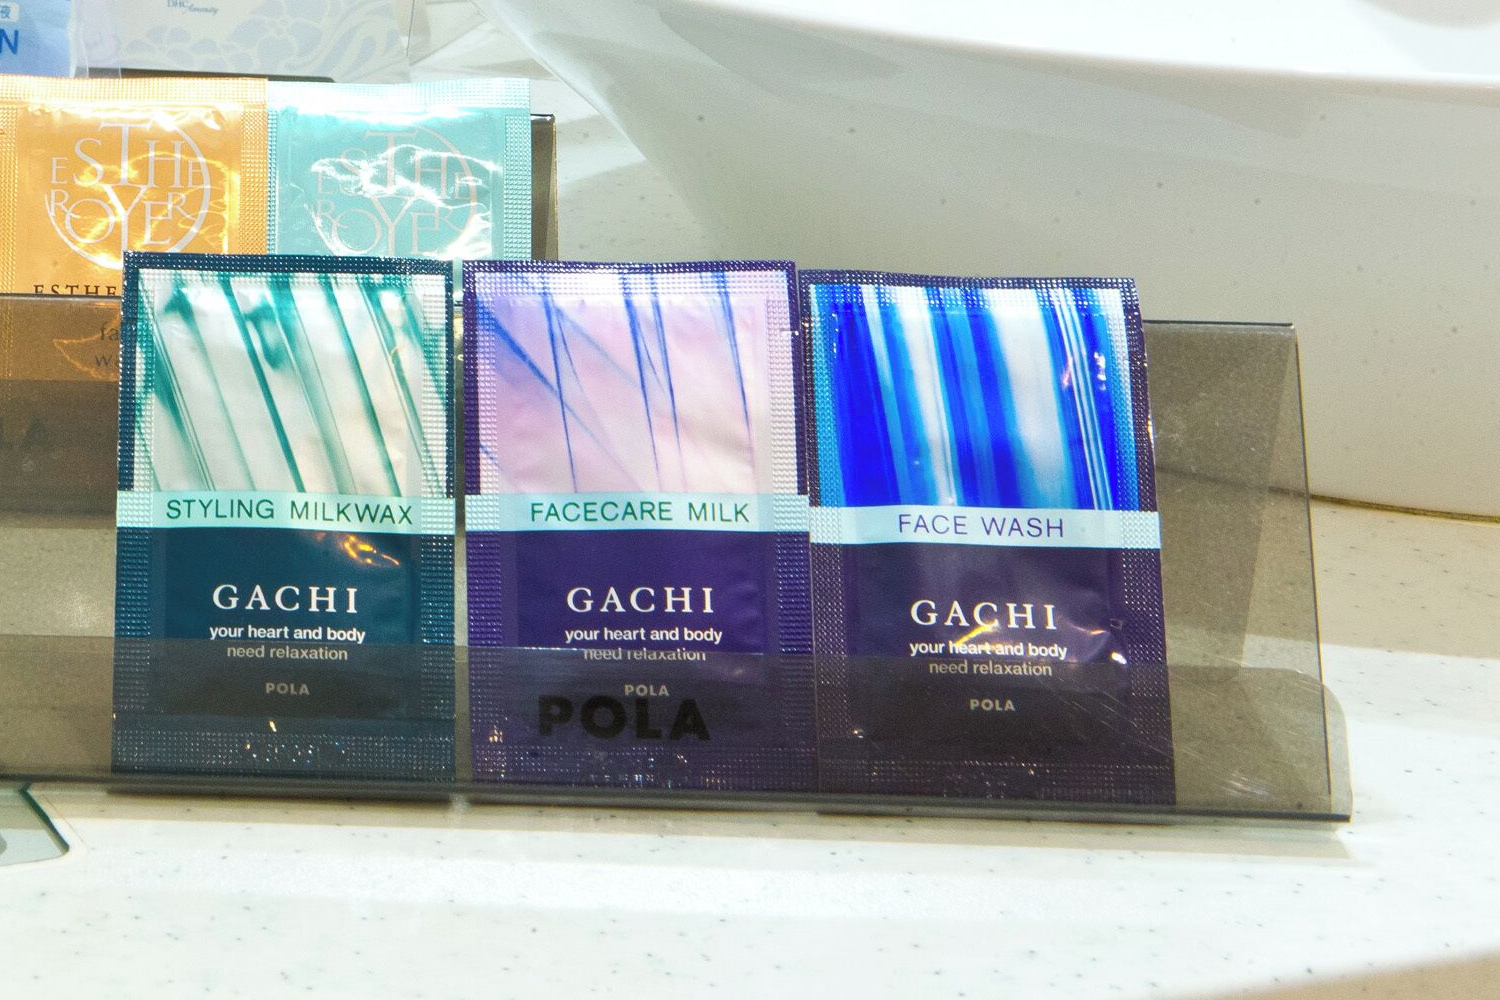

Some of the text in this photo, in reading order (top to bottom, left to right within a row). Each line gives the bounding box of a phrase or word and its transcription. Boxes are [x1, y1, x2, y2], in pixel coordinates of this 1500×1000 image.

[167, 0, 188, 9] DHC
[166, 499, 414, 526] STYLING MILKWAX
[530, 500, 750, 524] FACECARE MILK
[898, 513, 1065, 539] FACE WASH
[212, 583, 359, 614] GACHI
[566, 585, 715, 614] GACHI
[910, 599, 1058, 631] GACHI
[209, 624, 366, 645] your heart and body
[565, 626, 723, 646] your heart and body
[226, 645, 349, 661] need relaxation
[583, 648, 624, 661] need
[909, 640, 1068, 661] your heart and body
[929, 660, 1052, 677] need relaxation
[265, 682, 310, 696] POLA
[624, 684, 670, 697] POLA
[969, 698, 1016, 712] POLA
[537, 696, 711, 742] POLA
